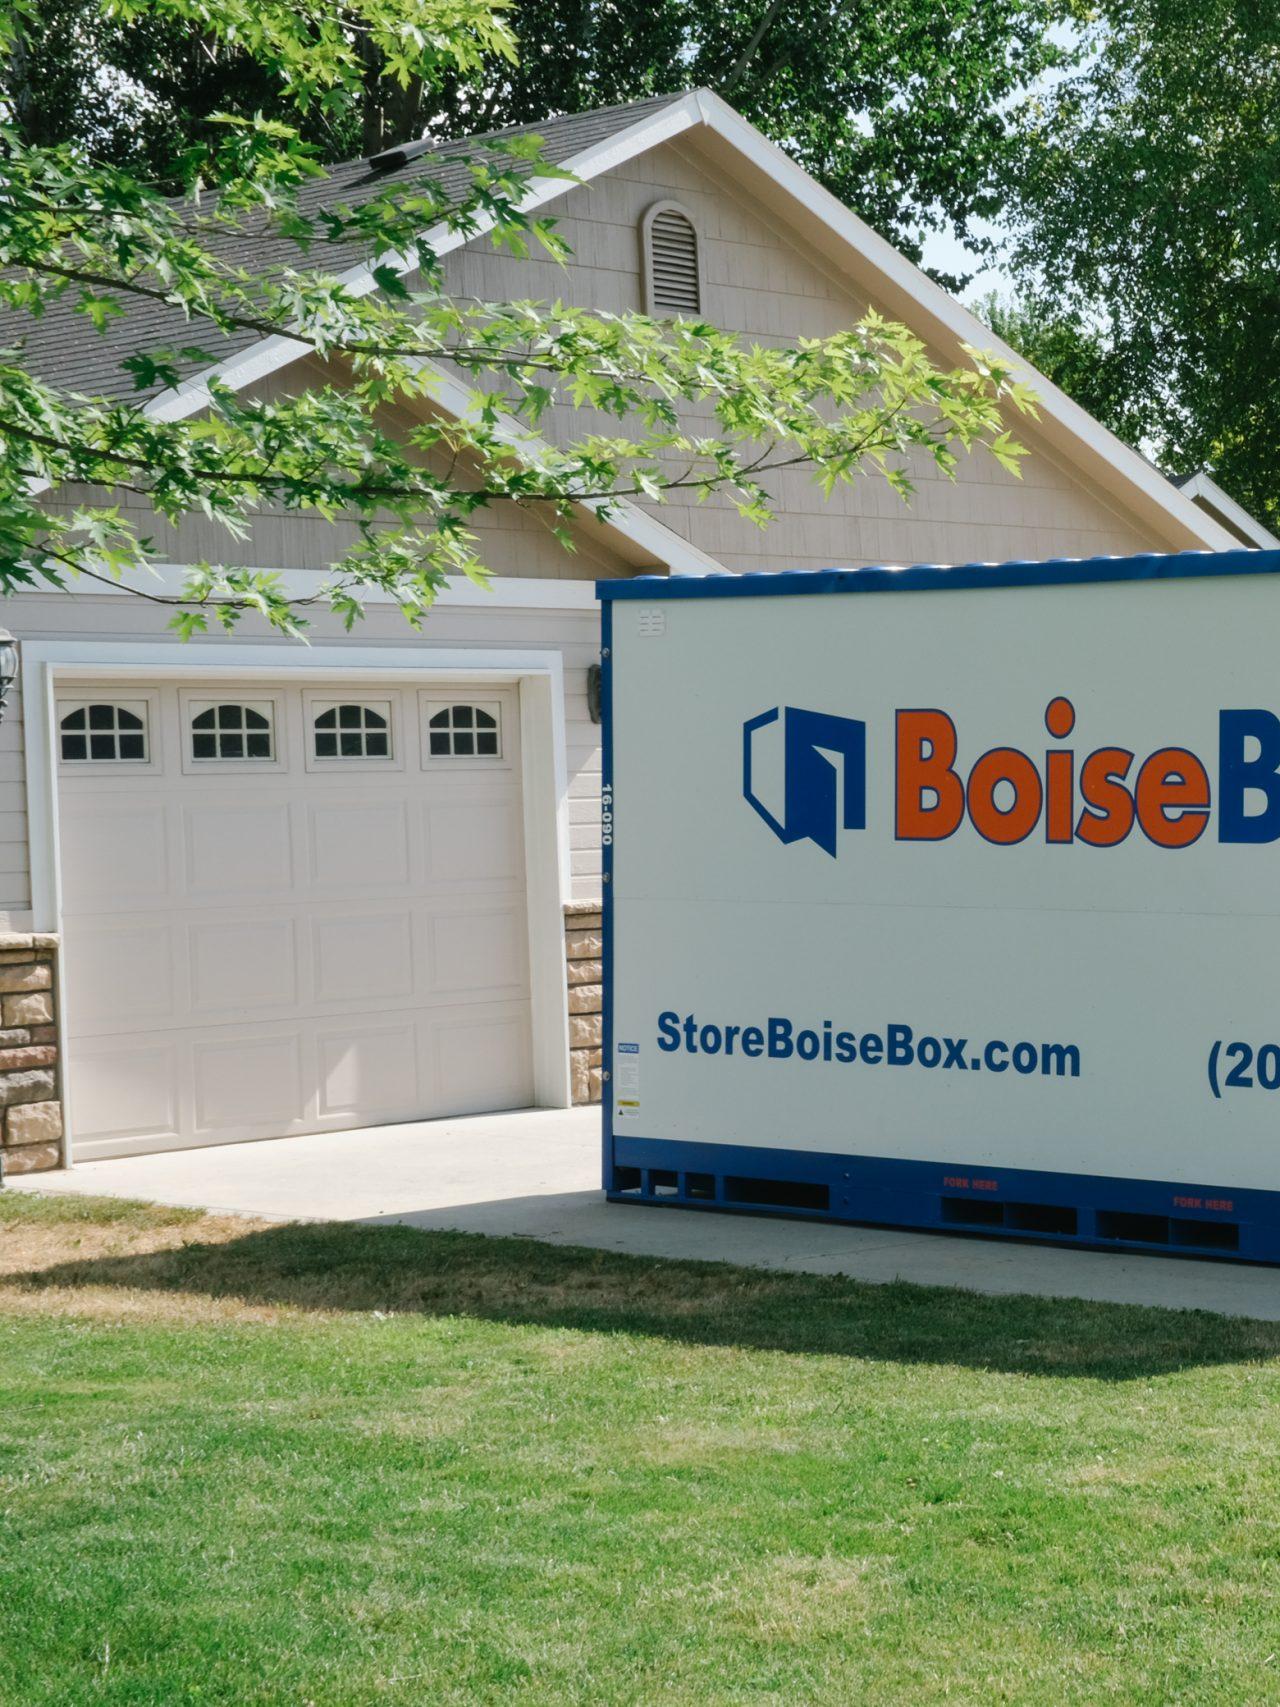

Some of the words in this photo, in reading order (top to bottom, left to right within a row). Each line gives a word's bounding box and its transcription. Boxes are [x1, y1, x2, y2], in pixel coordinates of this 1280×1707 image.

[602, 784, 612, 846] 16-090
[657, 1011, 1081, 1077] StoreBoiseBox.com
[943, 1177, 969, 1189] FORK
[972, 1179, 998, 1191] HERE
[1173, 1196, 1201, 1209] FORK
[1205, 1199, 1234, 1211] HERE
